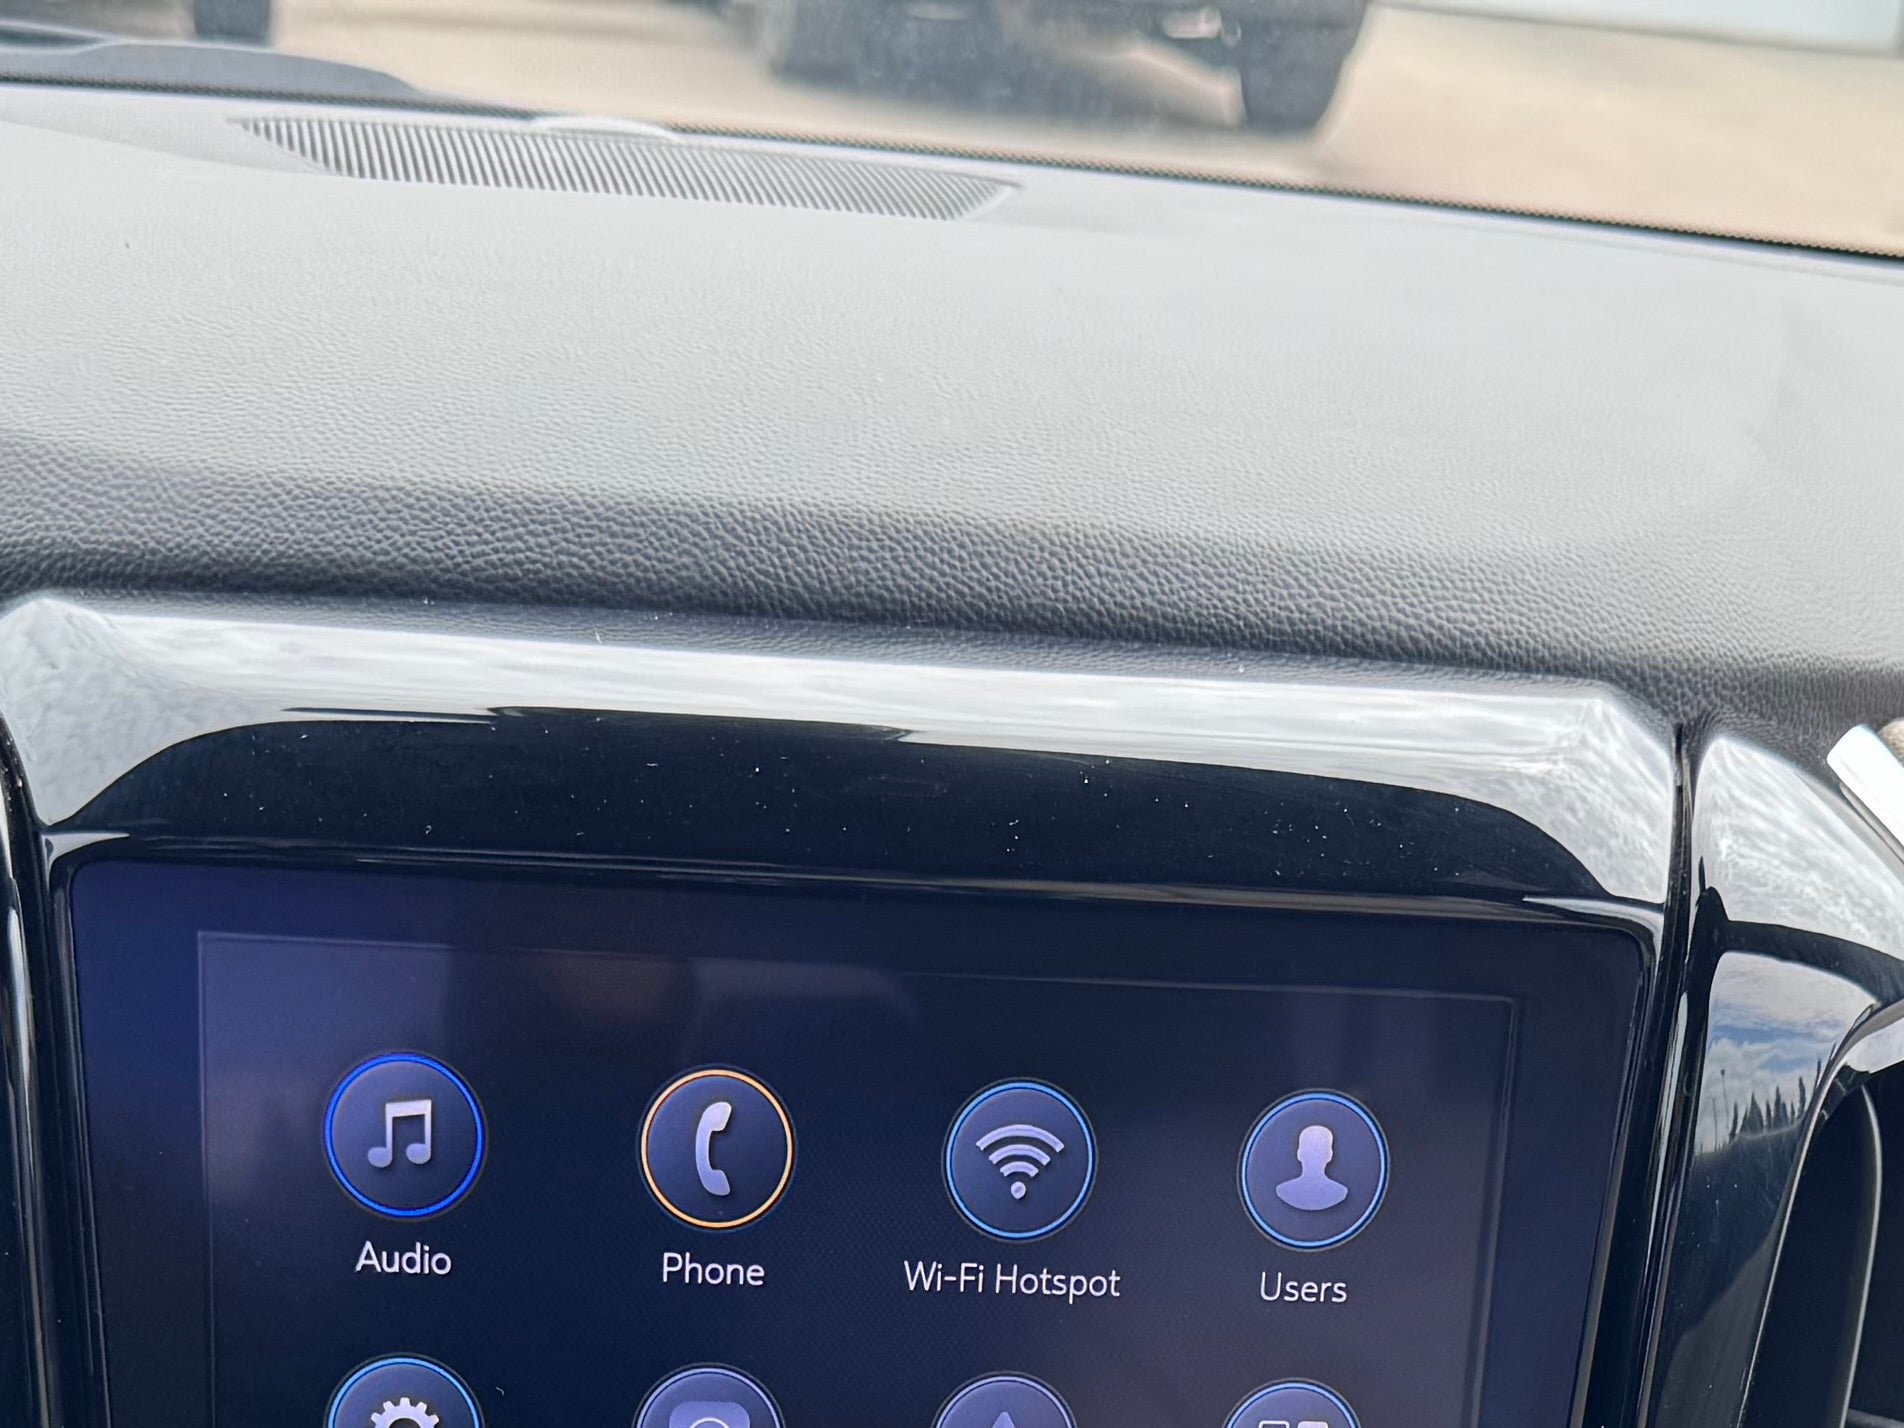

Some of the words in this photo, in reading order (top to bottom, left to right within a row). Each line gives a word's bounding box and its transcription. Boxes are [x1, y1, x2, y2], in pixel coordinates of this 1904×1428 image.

[355, 1241, 452, 1275] Audio
[662, 1253, 765, 1286] Phone
[904, 1261, 984, 1294] Wi-Fi
[995, 1264, 1121, 1304] Hotspot
[1260, 1272, 1348, 1303] Users
